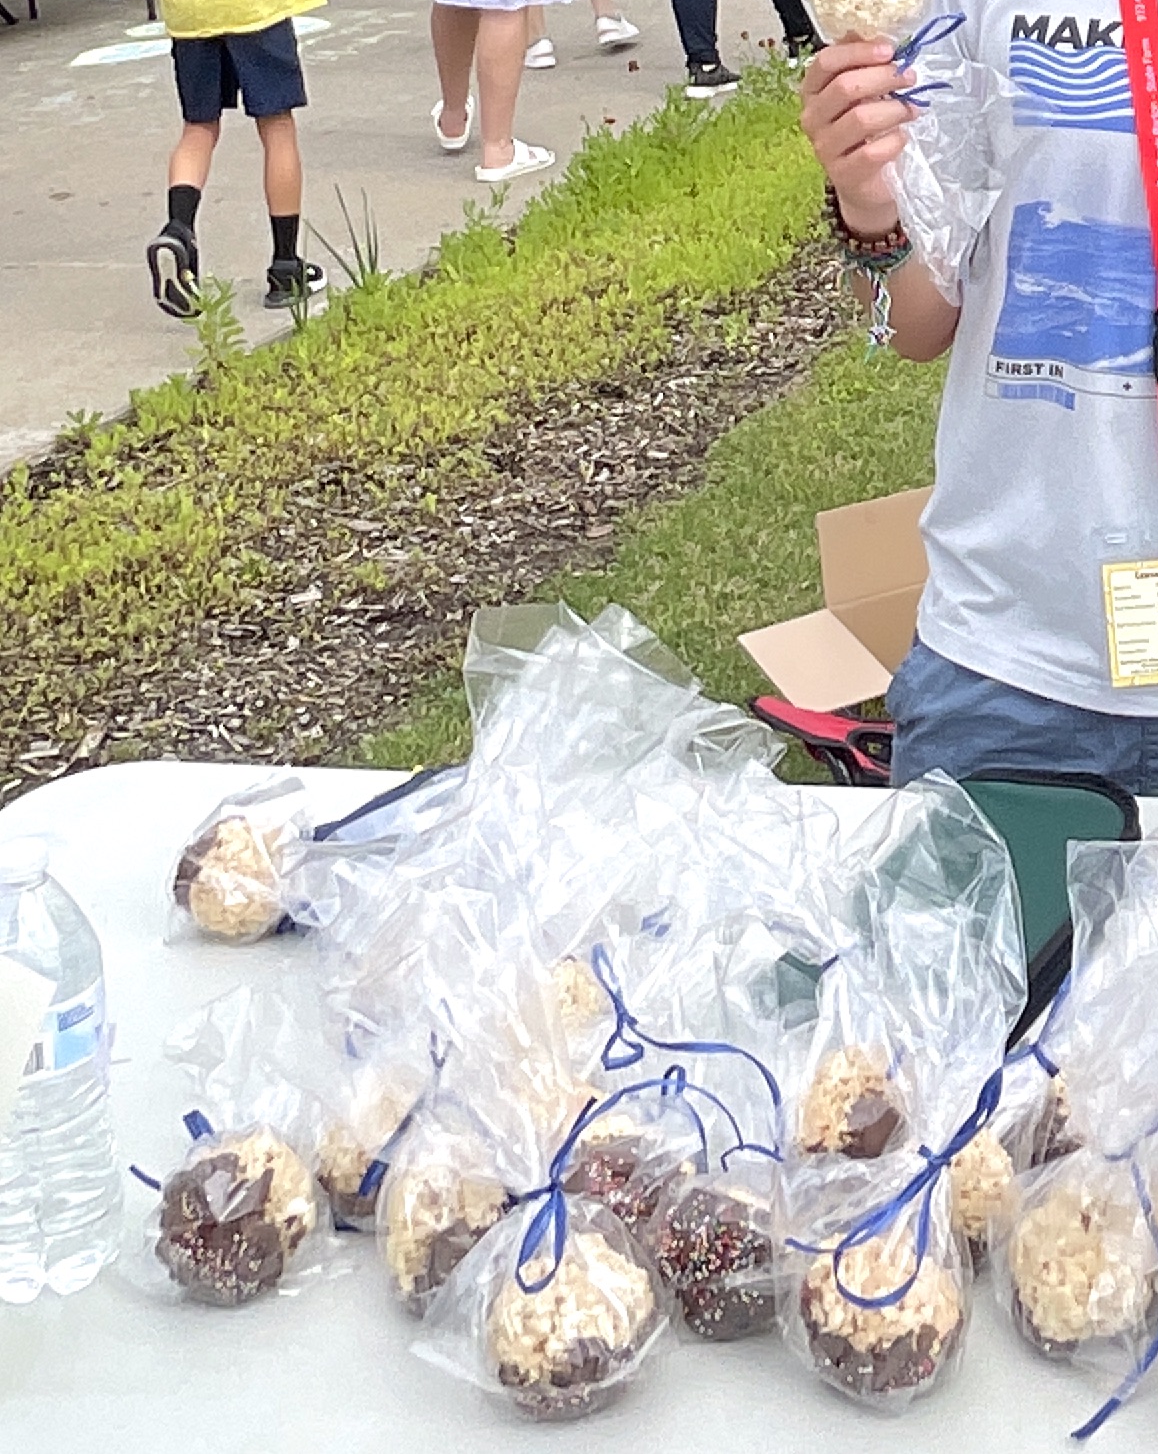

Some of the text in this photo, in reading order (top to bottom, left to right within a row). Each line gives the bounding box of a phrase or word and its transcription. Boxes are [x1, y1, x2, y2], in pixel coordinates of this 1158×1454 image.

[1011, 14, 1124, 50] MAK
[994, 360, 1045, 376] FIRST
[1048, 364, 1064, 379] IN
